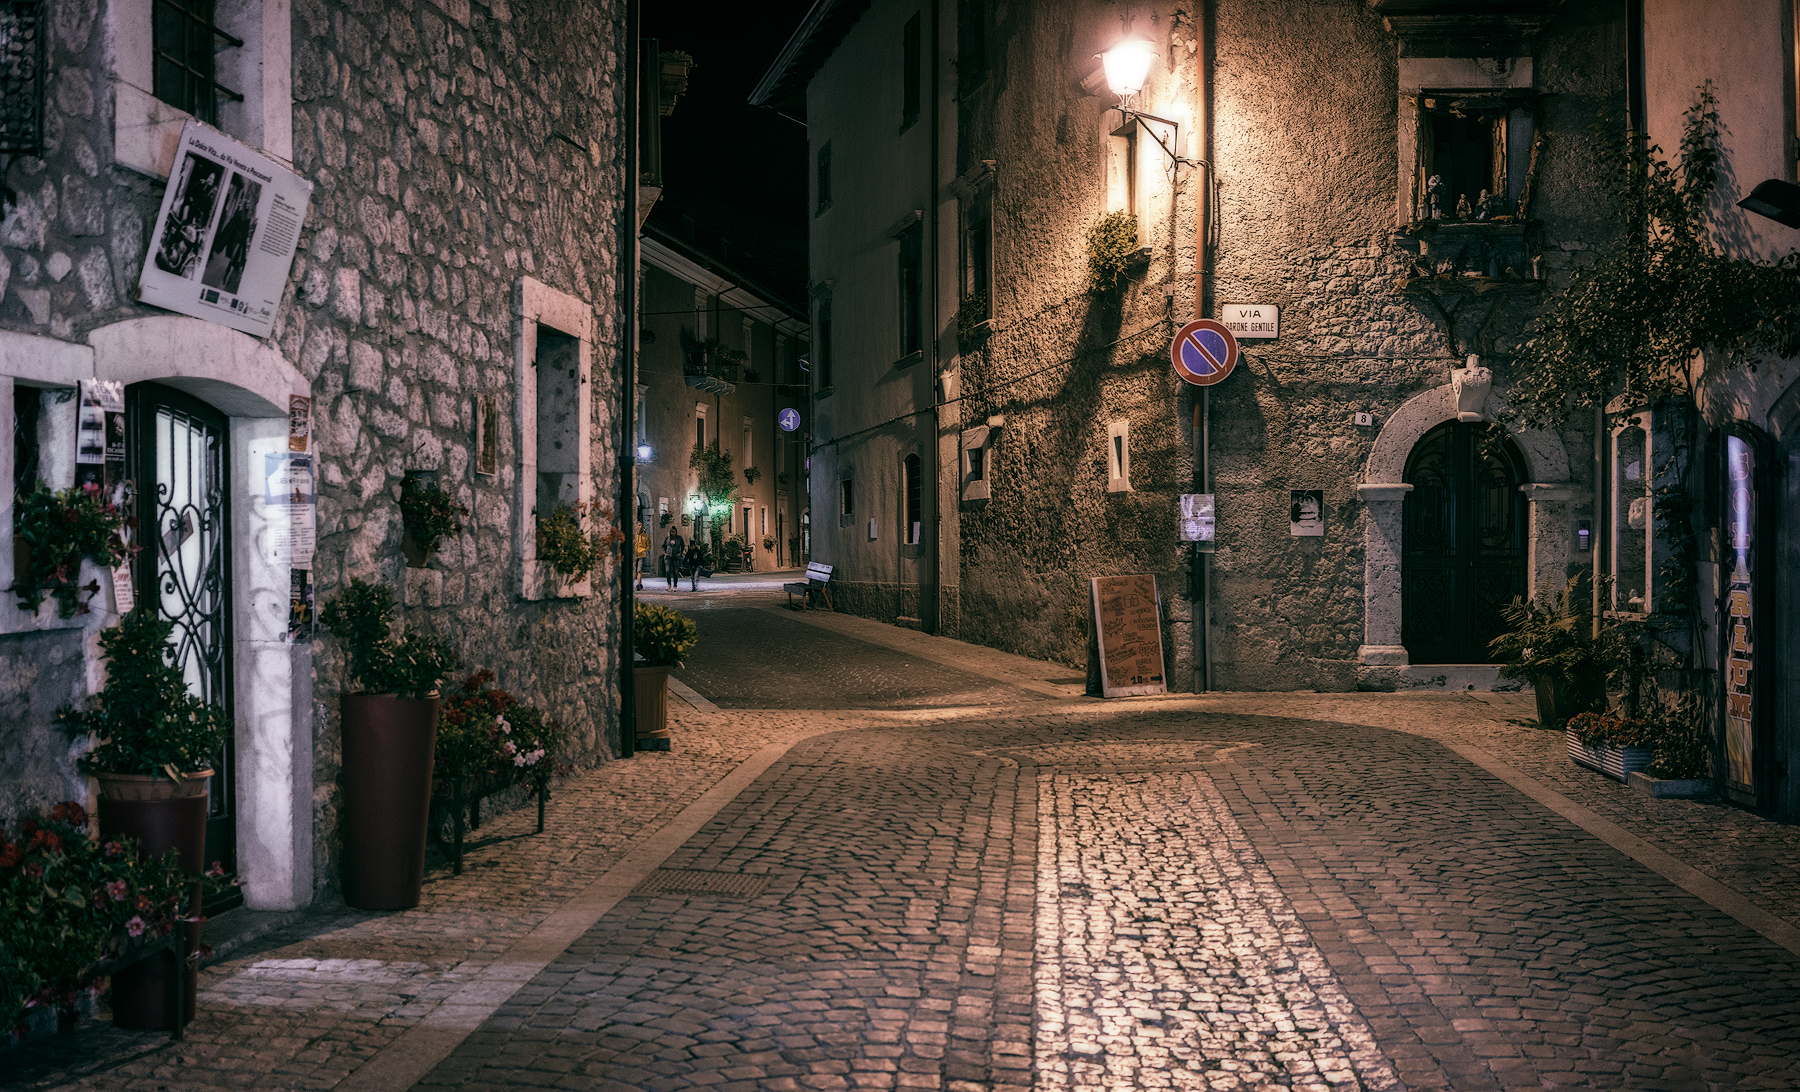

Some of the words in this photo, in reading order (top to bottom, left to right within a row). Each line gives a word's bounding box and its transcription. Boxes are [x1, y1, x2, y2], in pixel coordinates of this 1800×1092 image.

[189, 137, 194, 145] La
[195, 140, 208, 152] Dolce
[1250, 322, 1274, 332] GENTILE
[1361, 414, 1366, 423] 8
[1729, 452, 1752, 721] SOLARIUM
[1131, 675, 1143, 685] 10
